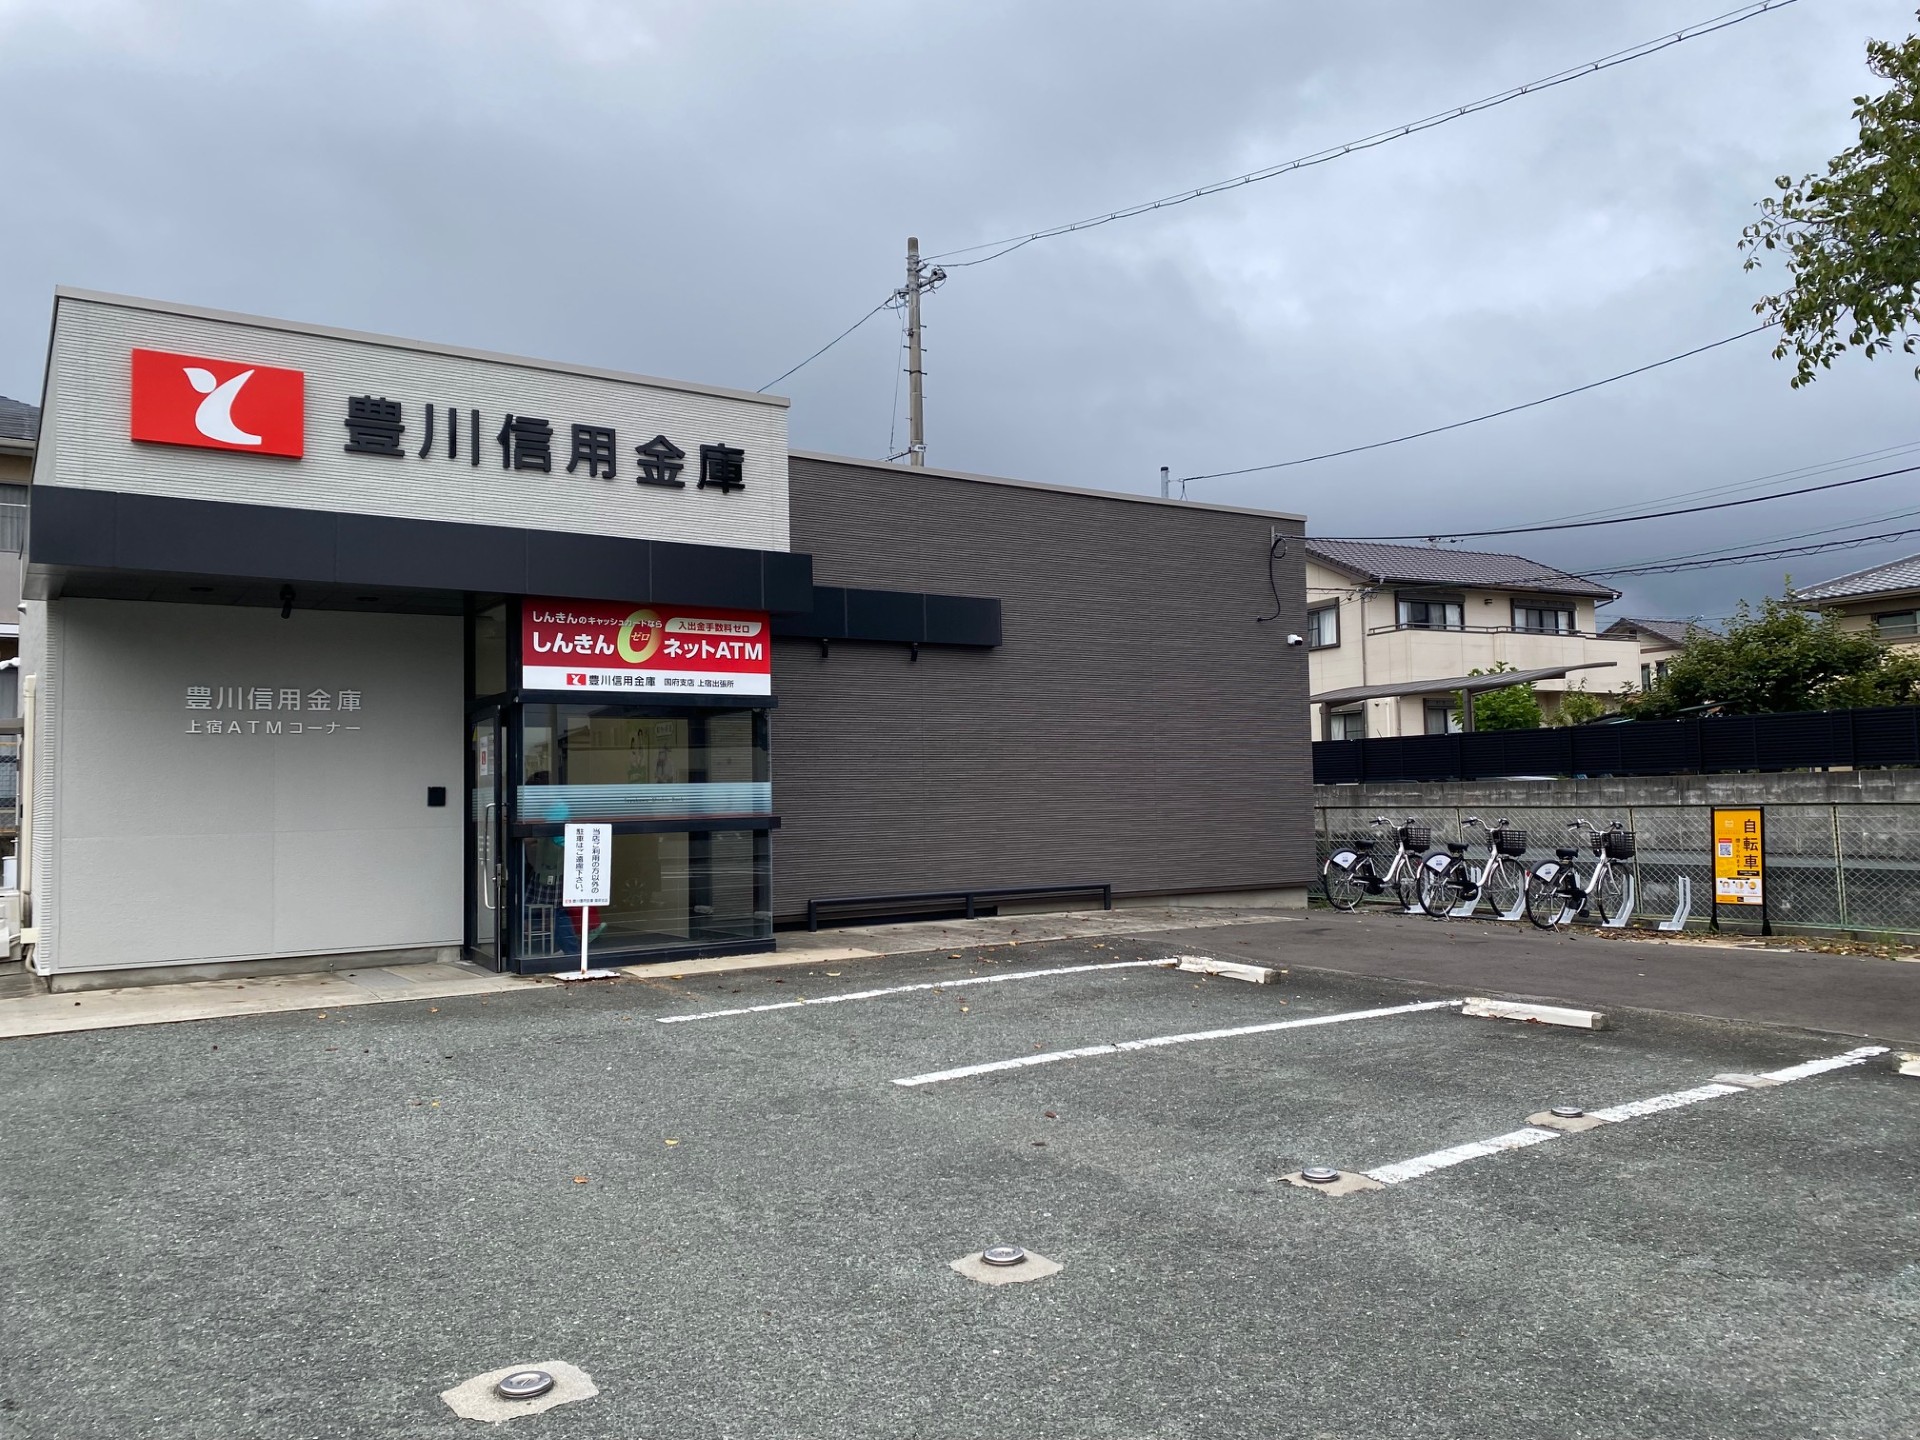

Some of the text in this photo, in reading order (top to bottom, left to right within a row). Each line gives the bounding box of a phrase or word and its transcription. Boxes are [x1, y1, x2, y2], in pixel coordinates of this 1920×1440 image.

[344, 395, 746, 494] 豊川信用金庫
[532, 610, 662, 628] しんきんのキャッシュカードなら
[678, 621, 750, 634] 入出金手数料ゼロ
[533, 631, 615, 655] しんきん
[663, 638, 762, 661] ネットATM
[630, 631, 651, 641] ゼロ
[588, 674, 734, 688] 豊川信用金庫 国府支店 上宿出張所
[185, 686, 362, 712] 豊川信用金庫
[185, 719, 361, 735] 上宿ATMコーナー
[1743, 819, 1759, 869] 自転車
[575, 828, 585, 892] 駐車はご遠慮下さい。
[591, 828, 601, 894] 当店ご利用の方以外の
